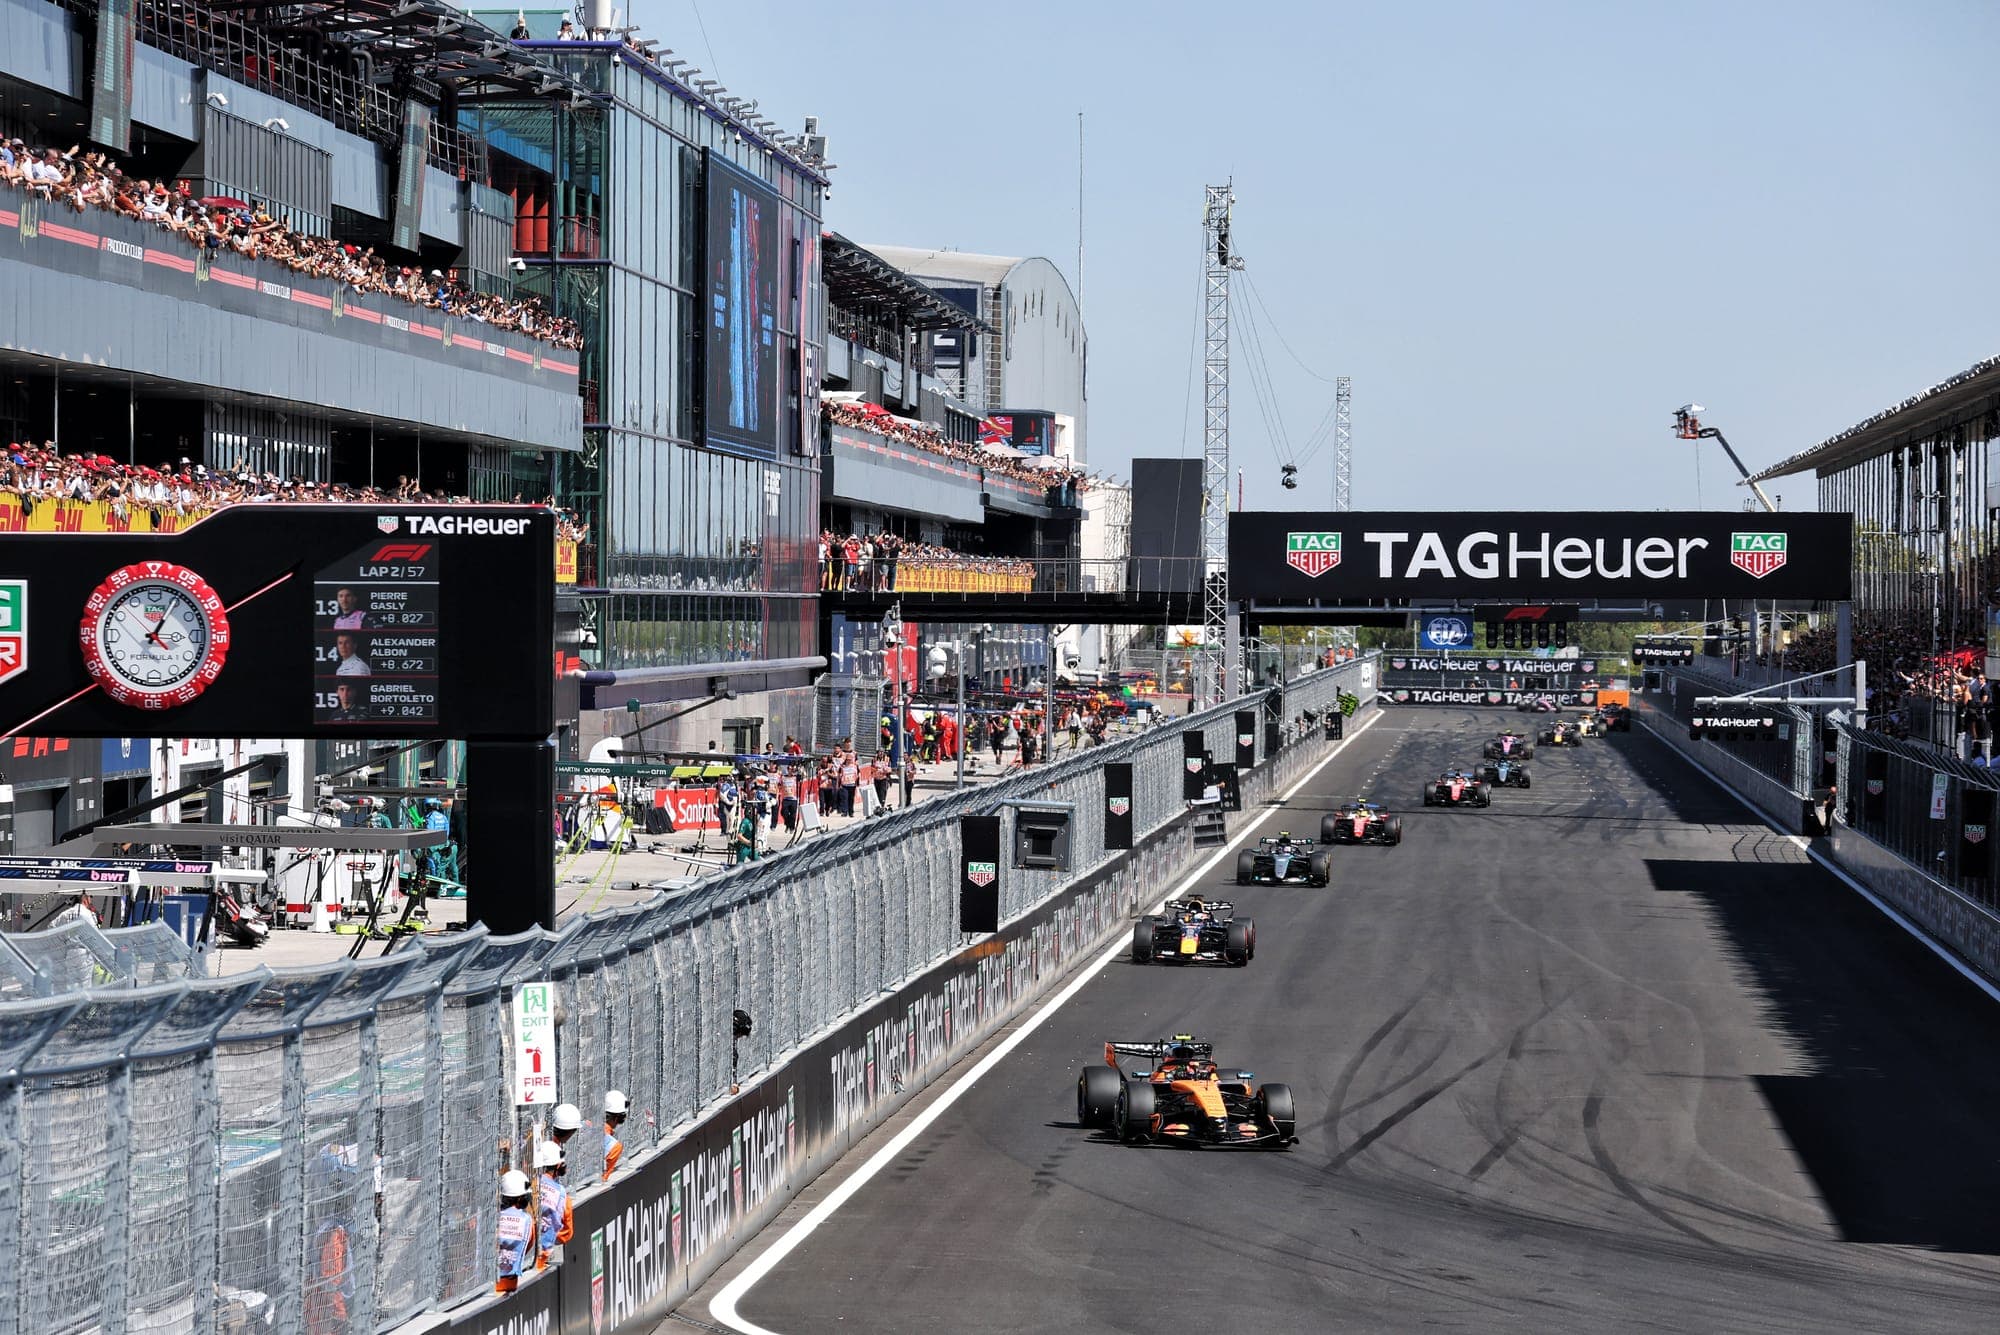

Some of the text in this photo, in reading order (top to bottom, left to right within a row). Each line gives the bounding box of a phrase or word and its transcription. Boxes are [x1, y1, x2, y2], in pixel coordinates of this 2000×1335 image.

[1293, 535, 1337, 549] TAG
[1737, 535, 1782, 549] TAG
[1290, 553, 1339, 574] HEUER
[1734, 553, 1784, 574] HEUER
[111, 570, 129, 584] 55
[179, 569, 198, 586] 05
[360, 567, 389, 577] LAP
[88, 592, 103, 610] 50
[371, 592, 408, 600] PIERRE
[207, 596, 219, 610] 10
[316, 601, 339, 615] 13
[371, 602, 406, 610] GASLY
[381, 614, 424, 624] +8.027
[81, 627, 91, 644] 45
[218, 631, 227, 644] 15
[1431, 624, 1462, 640] FIA
[316, 647, 339, 662] 14
[371, 649, 408, 657] ALBON
[86, 660, 101, 677] 40
[204, 661, 221, 680] 20
[381, 660, 424, 670] +8.672
[110, 687, 129, 701] 35
[178, 687, 198, 702] 25
[371, 685, 416, 693] GABRIEL
[144, 699, 163, 709] 30
[316, 693, 339, 708] 15
[371, 695, 434, 703] BORTOLETO
[381, 706, 424, 716] +9.042
[60, 860, 82, 868] MSC
[184, 865, 208, 873] BWT
[971, 863, 994, 872] TAG
[100, 873, 125, 881] BWT
[522, 1017, 549, 1027] EXIT
[524, 1077, 551, 1087] FIRE
